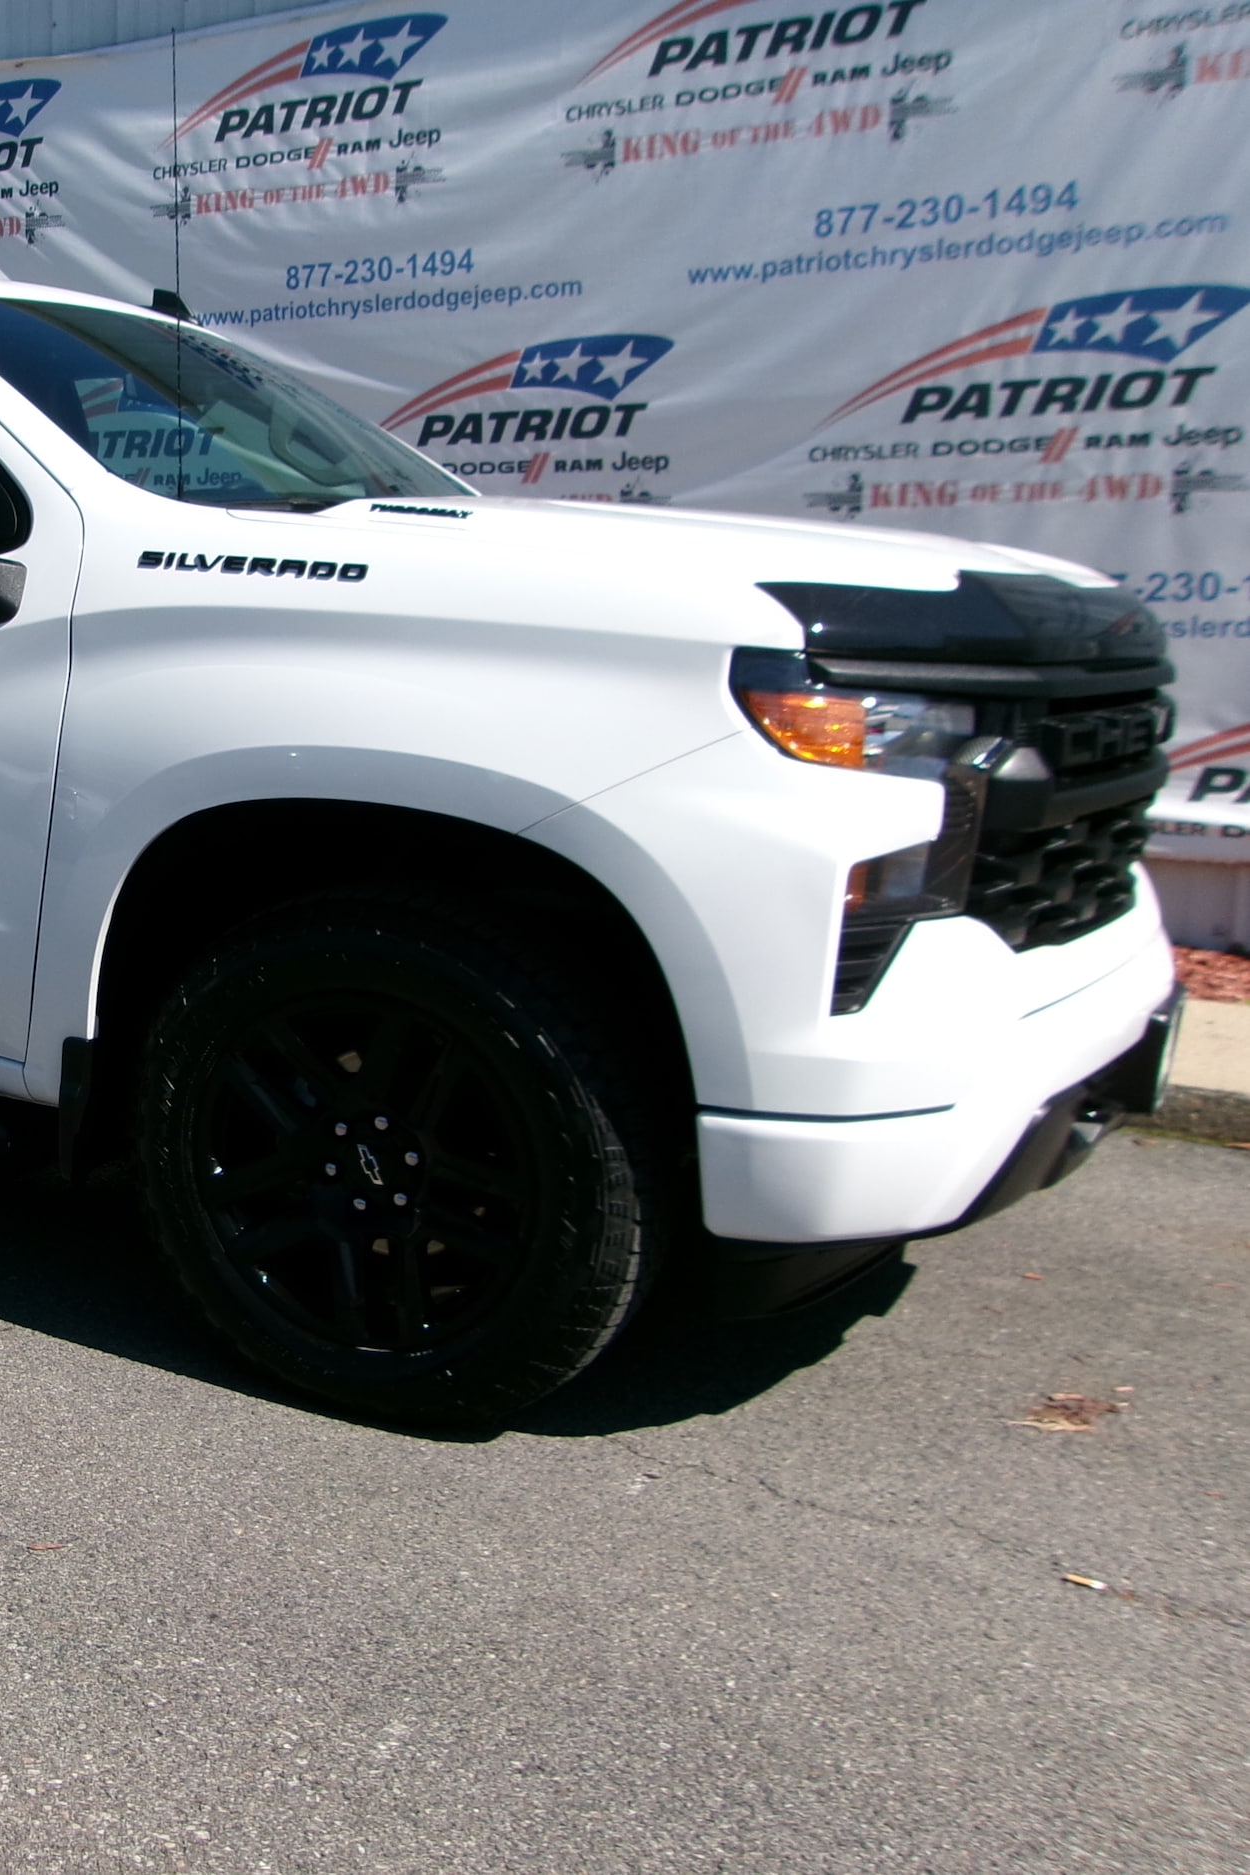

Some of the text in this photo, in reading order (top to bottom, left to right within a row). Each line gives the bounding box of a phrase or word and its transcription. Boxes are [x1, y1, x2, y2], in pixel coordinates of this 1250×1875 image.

[648, 0, 927, 78] PATRIOT
[565, 50, 952, 124] CHRYSLER DODGE RAM Jeep
[1194, 49, 1250, 85] KI
[214, 78, 424, 143] PATRIOT
[153, 127, 441, 180] CHRYSLER DODGE RAM Jeep
[621, 104, 882, 164] KING OF THE 4WD
[19, 180, 59, 197] Jeep
[196, 172, 390, 215] KING OF THE 4WD
[814, 179, 1081, 239] 877-230-1494
[286, 248, 474, 291] 877-230-1494
[688, 211, 1230, 285] www.patriotchryslerdodgejeep.com
[197, 278, 583, 329] www.patriotchryslerdodgejeep.com
[900, 365, 1218, 425] PATRIOT
[417, 403, 648, 447] PATRIOT
[808, 424, 1243, 464] CHRYSLER DODGE RAM Jeep
[197, 467, 242, 486] Jeep
[554, 458, 603, 472] RAM
[612, 452, 669, 474] Jeep
[869, 480, 958, 509] KING
[1082, 473, 1163, 501] 4WD
[136, 551, 369, 583] SILVERADO
